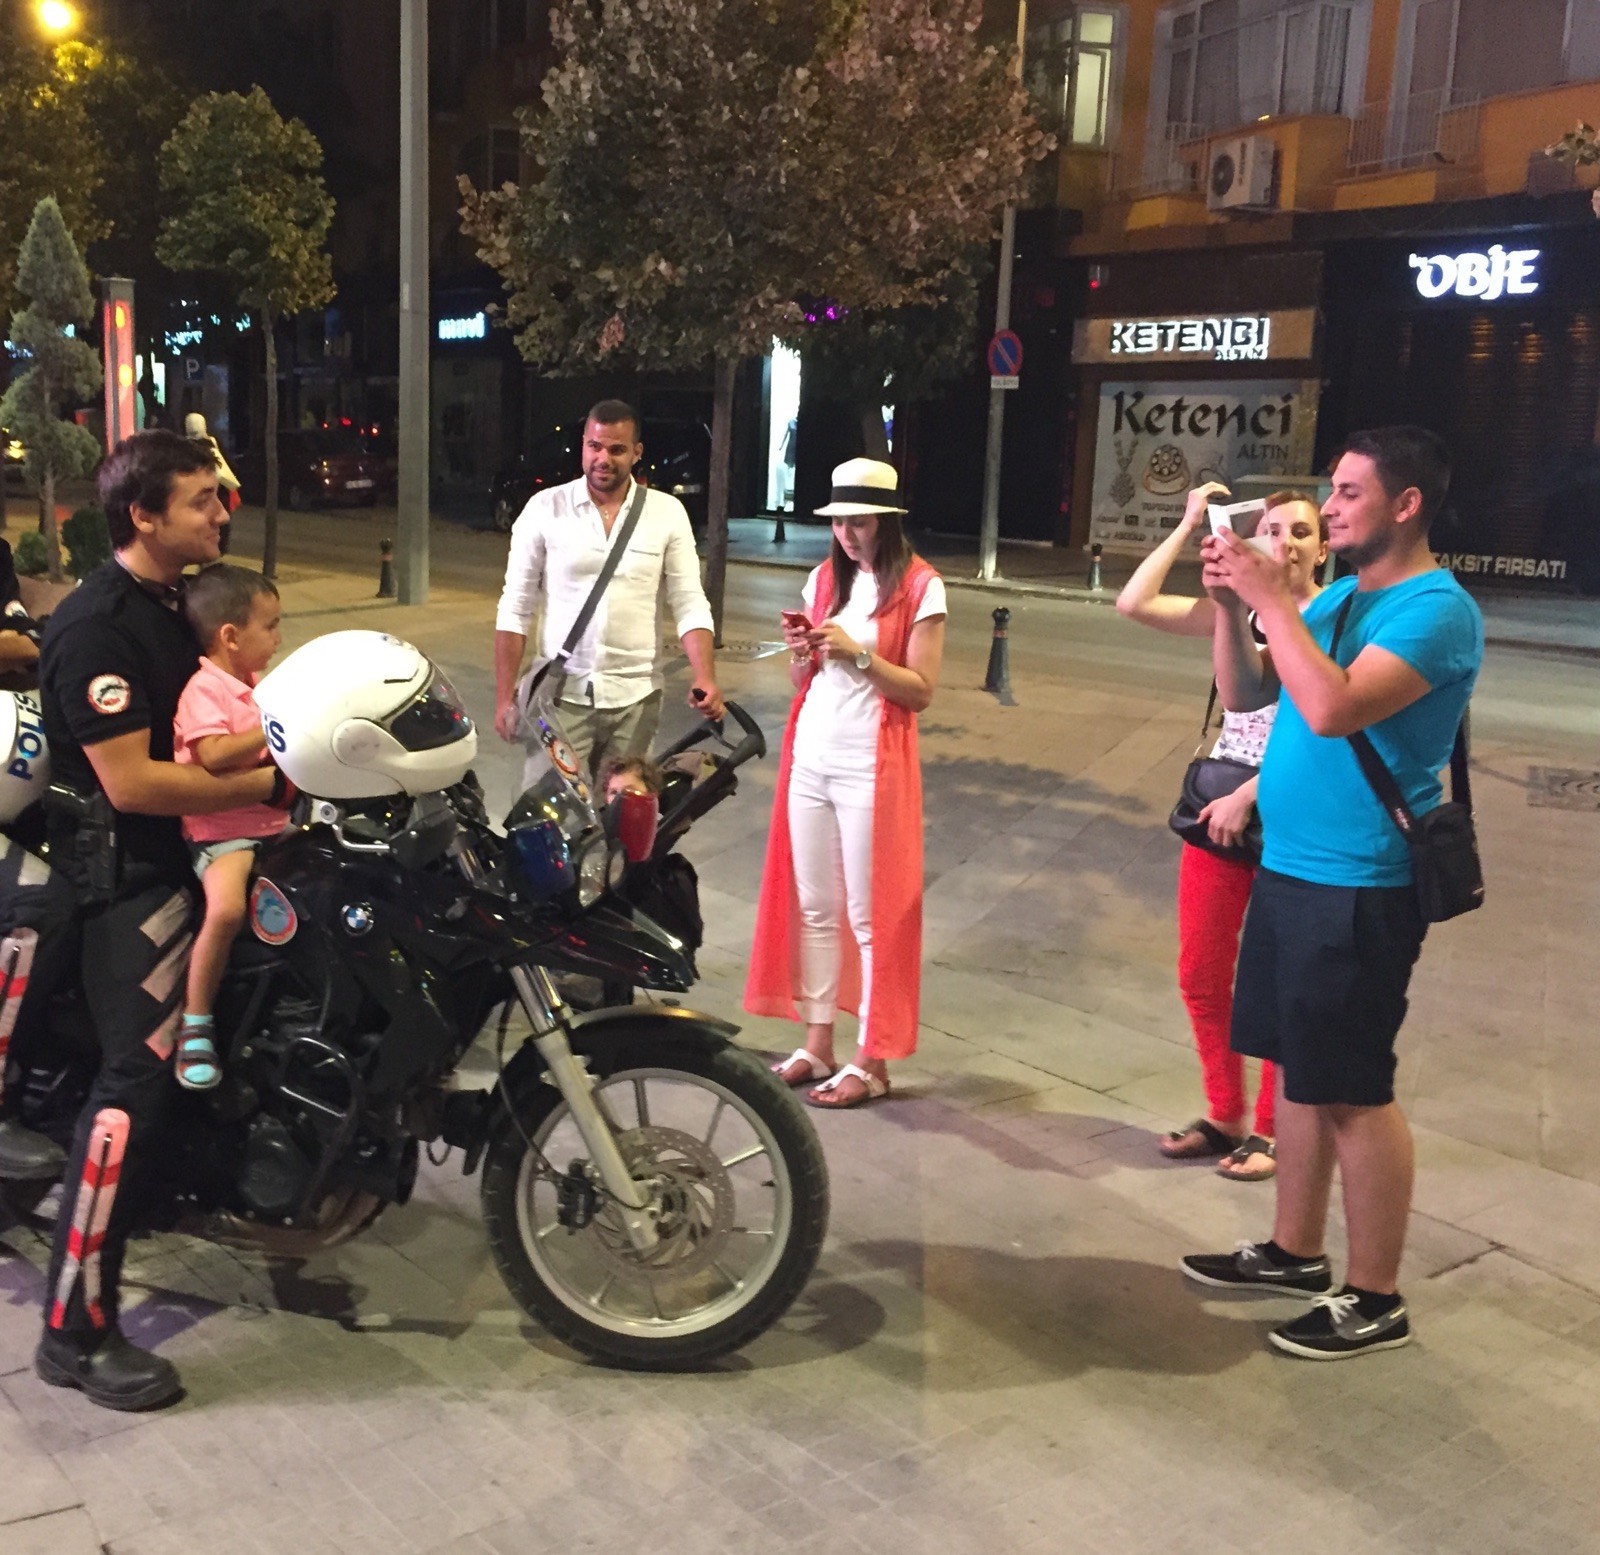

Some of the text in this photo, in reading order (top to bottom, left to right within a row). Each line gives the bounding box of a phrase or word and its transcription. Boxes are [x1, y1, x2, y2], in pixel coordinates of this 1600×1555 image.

[1113, 390, 1294, 438] Ketenci
[1236, 443, 1289, 461] ALTIN
[1494, 556, 1567, 579] FIRSATI
